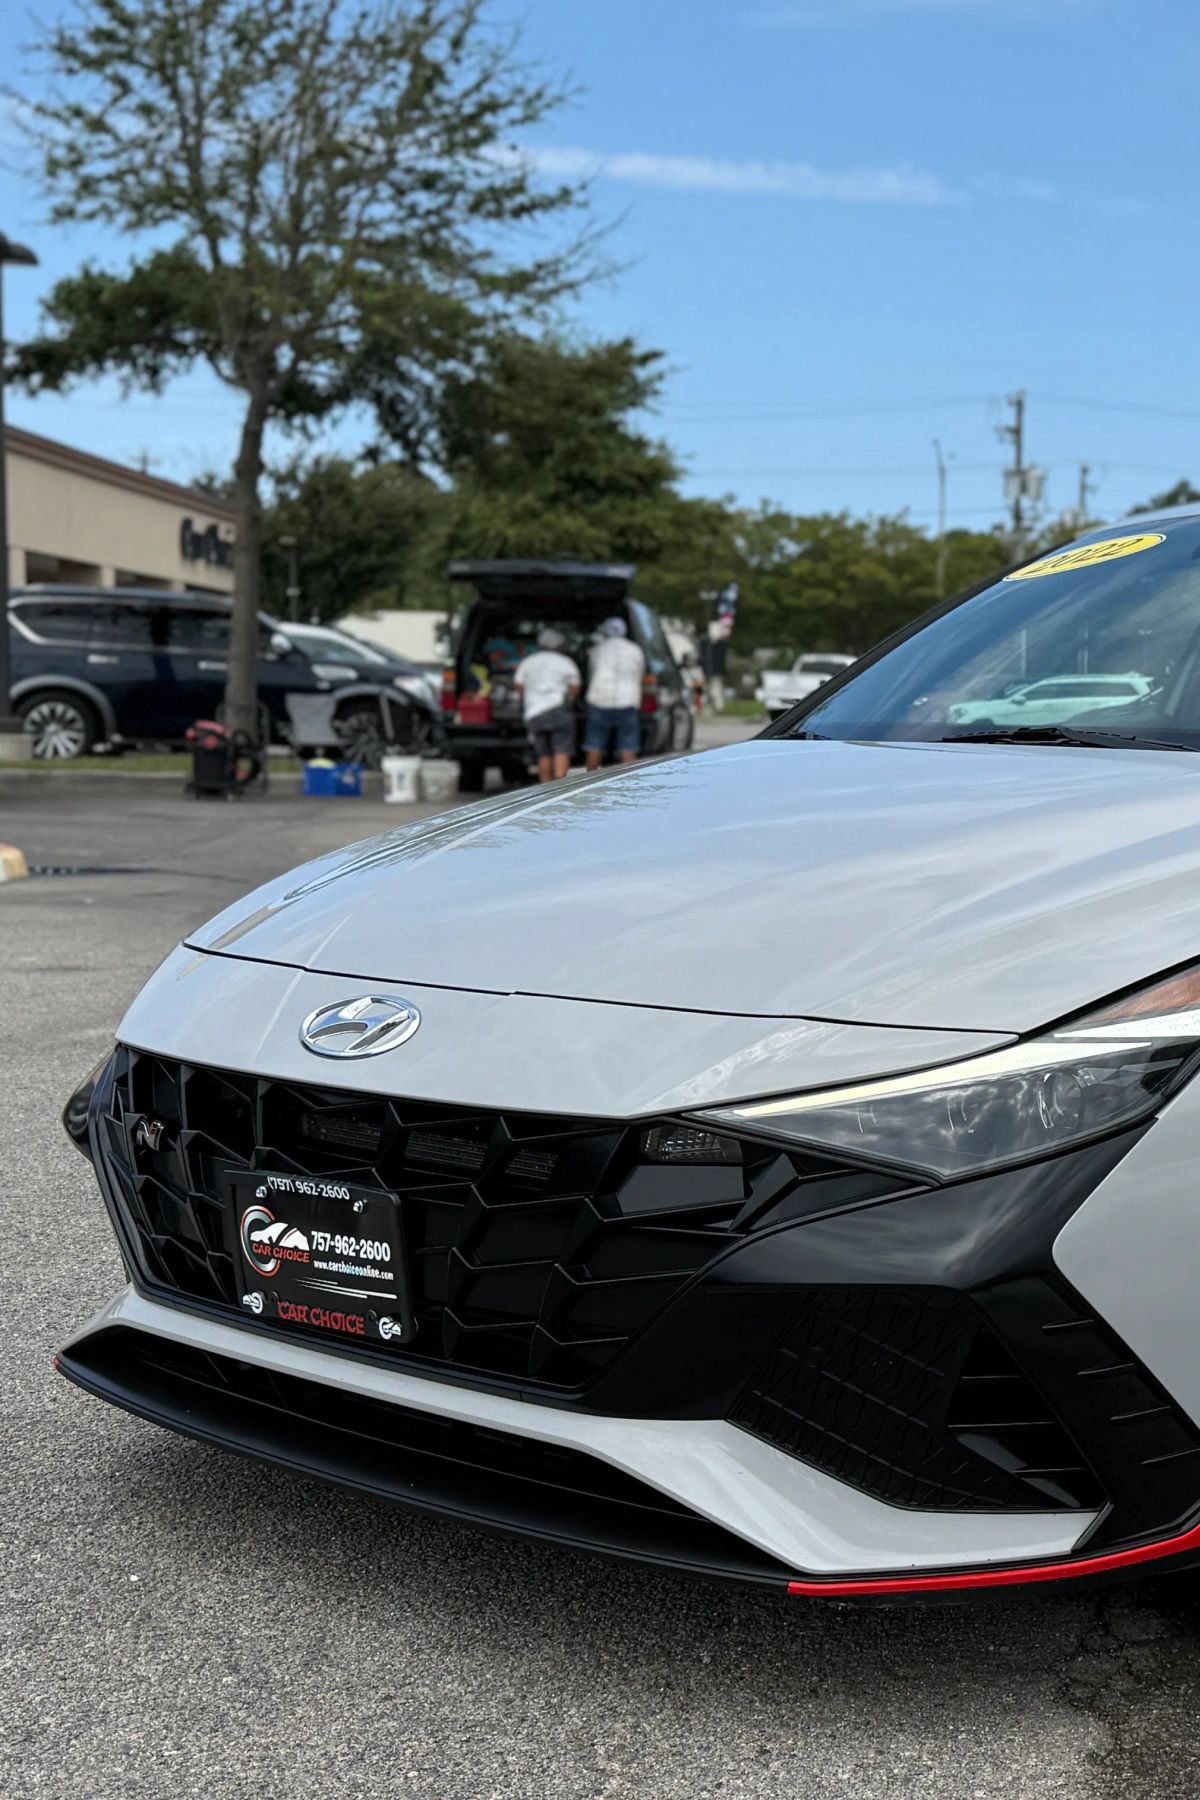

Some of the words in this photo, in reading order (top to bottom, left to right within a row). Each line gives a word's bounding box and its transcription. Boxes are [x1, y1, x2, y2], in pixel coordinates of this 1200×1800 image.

[1020, 538, 1144, 576] 2022
[267, 1176, 294, 1193] (757)
[295, 1181, 350, 1200] 962-2600
[252, 1243, 272, 1256] CAR
[272, 1247, 310, 1263] CHOICE
[311, 1231, 391, 1262] 757-962-2600
[277, 1301, 309, 1324] CAR
[310, 1307, 366, 1335] CHOICE
